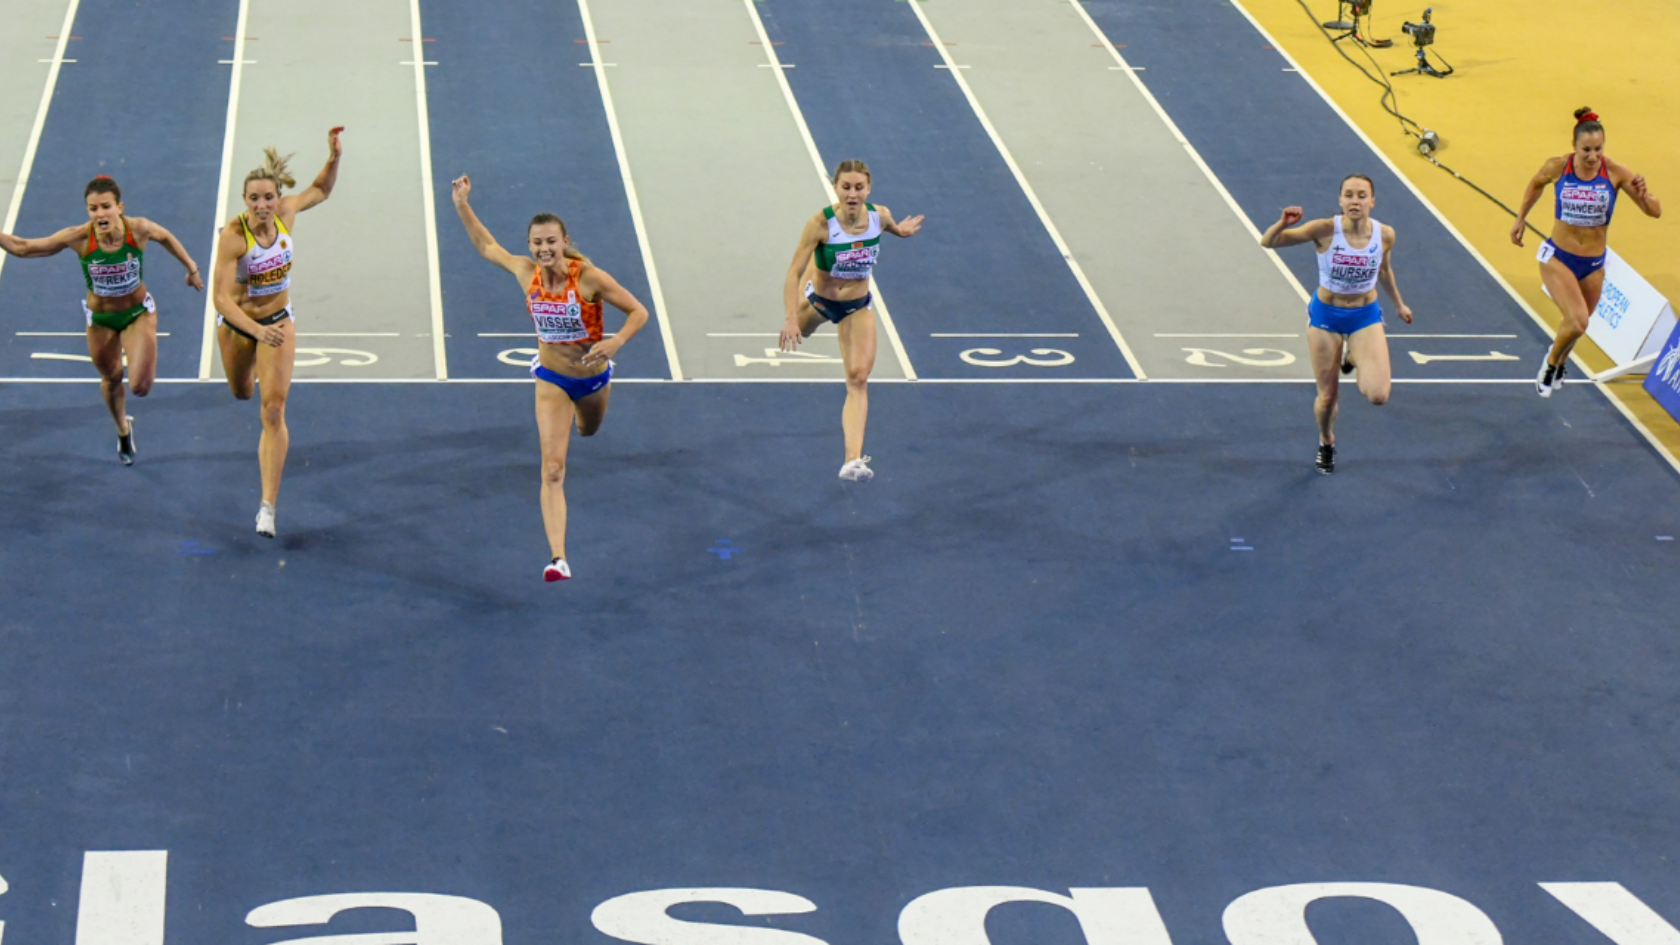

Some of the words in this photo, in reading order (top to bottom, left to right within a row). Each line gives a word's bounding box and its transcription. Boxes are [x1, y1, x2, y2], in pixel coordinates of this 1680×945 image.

[1562, 189, 1596, 201] SPAR
[249, 255, 283, 273] SPAR
[1333, 254, 1368, 266] SPAR
[90, 264, 127, 274] SPAR
[1602, 277, 1631, 315] UROPEAN
[533, 303, 567, 315] SPAR
[534, 315, 581, 329] VISSER
[959, 347, 1076, 367] 3
[1180, 347, 1297, 367] 2
[1408, 350, 1521, 365] 1
